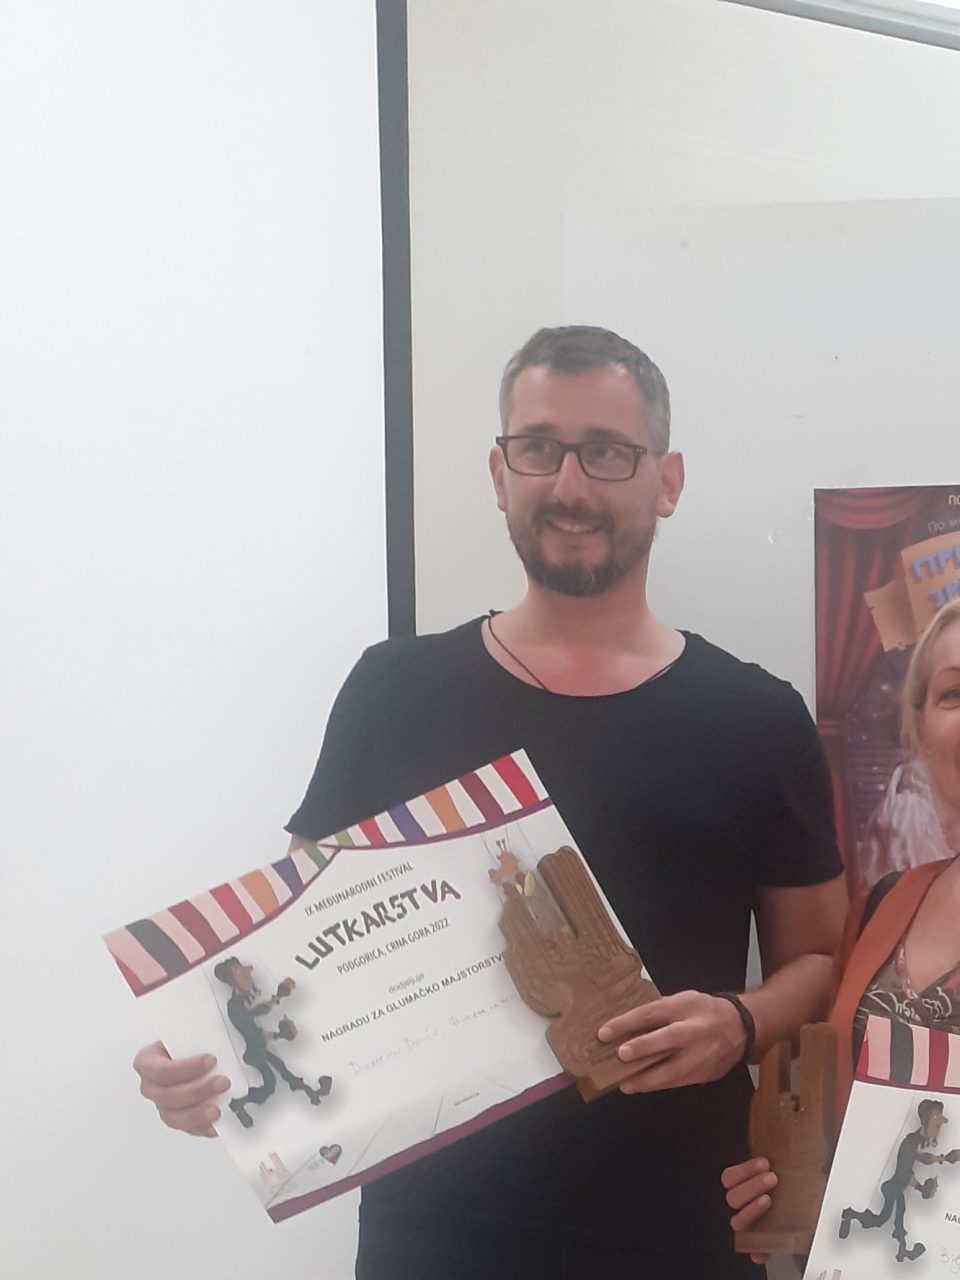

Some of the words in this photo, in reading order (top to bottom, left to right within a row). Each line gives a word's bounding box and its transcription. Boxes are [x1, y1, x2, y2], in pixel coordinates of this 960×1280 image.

[304, 906, 315, 917] IX
[376, 861, 414, 886] FESTIVAL
[294, 879, 462, 970] LUTKARSTVA
[336, 947, 387, 976] PODGORICA,
[385, 936, 409, 954] CRNA
[408, 926, 431, 944] GORA
[431, 917, 450, 934] 2022
[321, 1015, 371, 1043] NAGRADU
[371, 1008, 386, 1021] ZA
[385, 983, 441, 1013] GLUMAČKO
